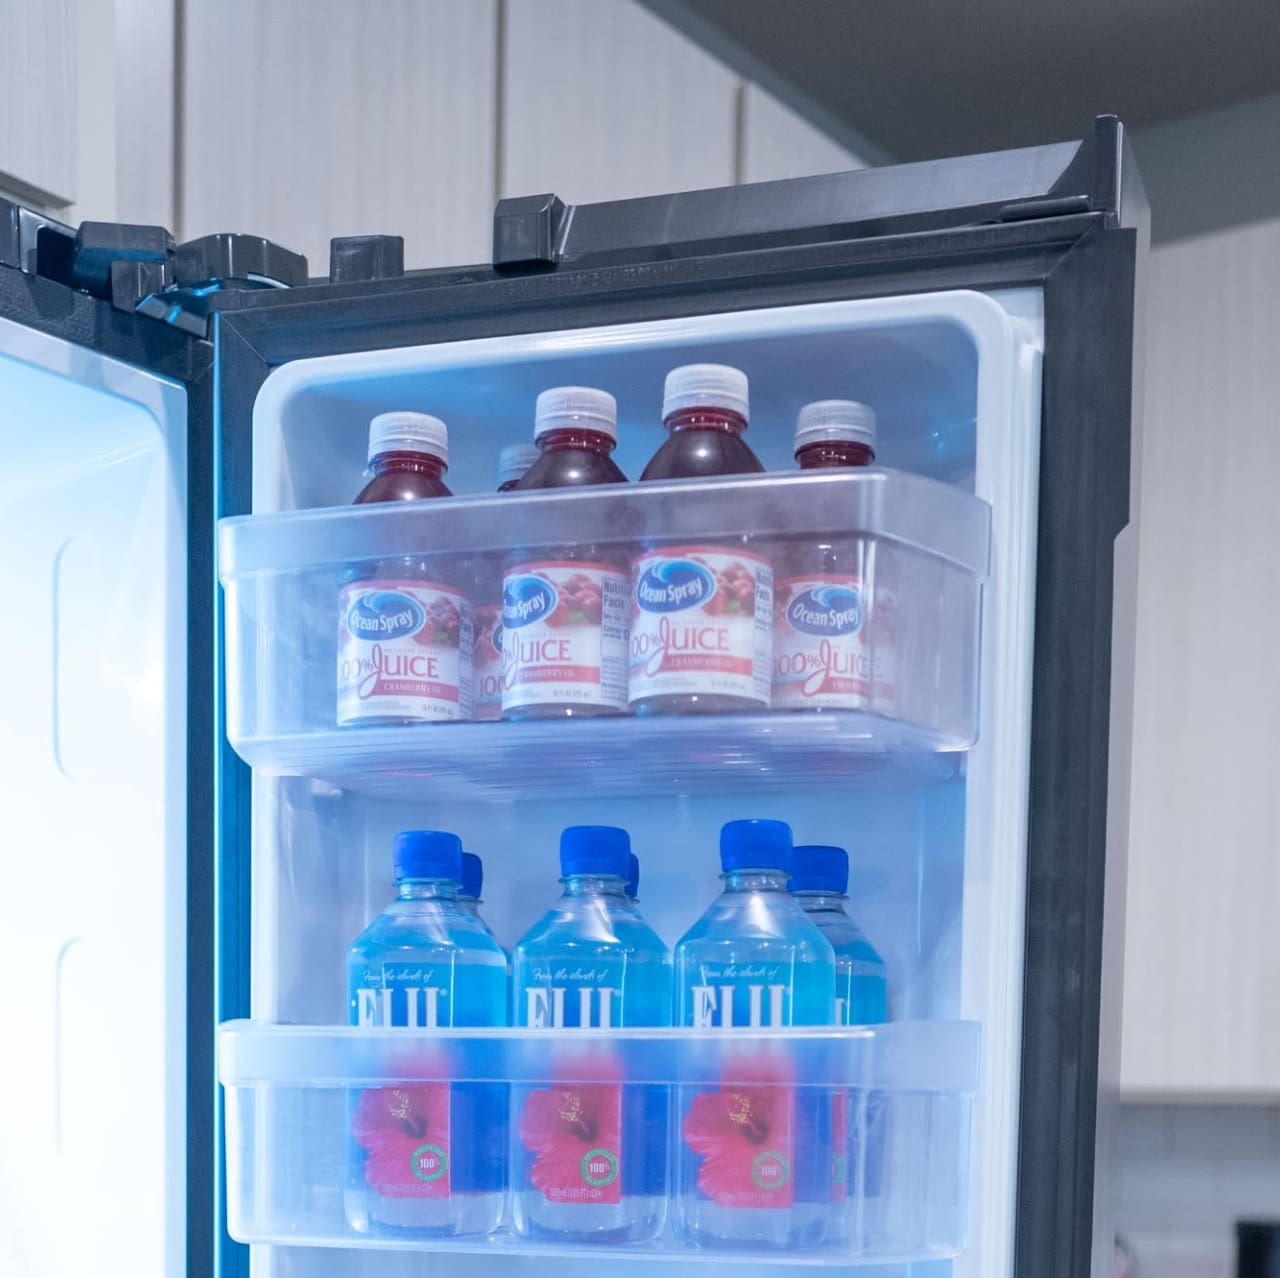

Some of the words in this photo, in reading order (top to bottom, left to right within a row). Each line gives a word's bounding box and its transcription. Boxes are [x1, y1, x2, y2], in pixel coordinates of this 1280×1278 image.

[640, 581, 666, 602] Ocean
[667, 578, 702, 604] Spray
[517, 591, 545, 620] Spray
[792, 603, 828, 626] Ocean
[829, 607, 858, 630] Spray
[350, 611, 379, 631] Ocean
[379, 608, 413, 633] Spray
[422, 968, 435, 983] of
[596, 968, 609, 983] of
[722, 964, 738, 978] the
[766, 965, 780, 980] of
